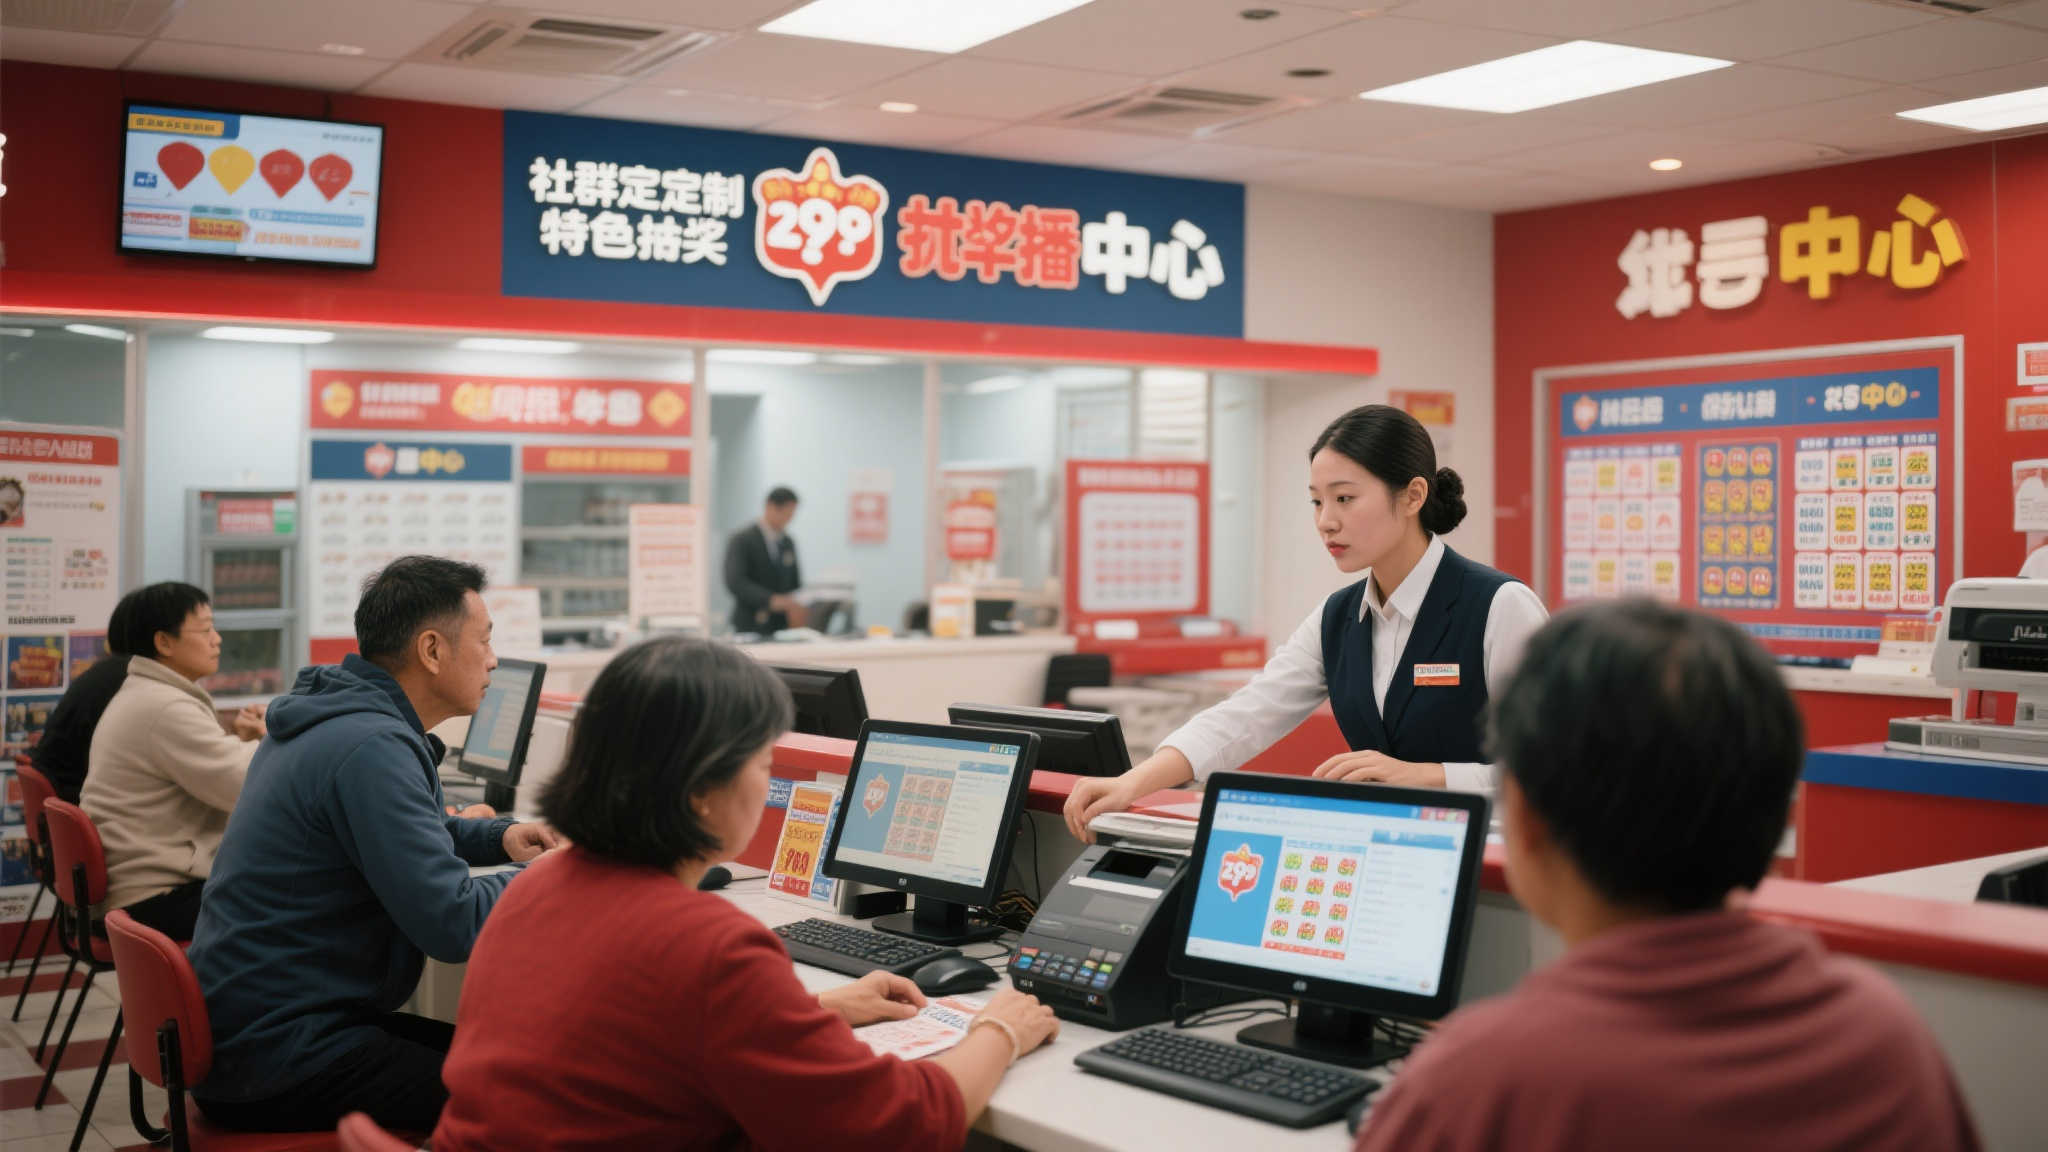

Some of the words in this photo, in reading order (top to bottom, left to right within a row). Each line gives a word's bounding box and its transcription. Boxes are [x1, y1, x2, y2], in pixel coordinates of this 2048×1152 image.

[529, 156, 746, 220] 社群定定制
